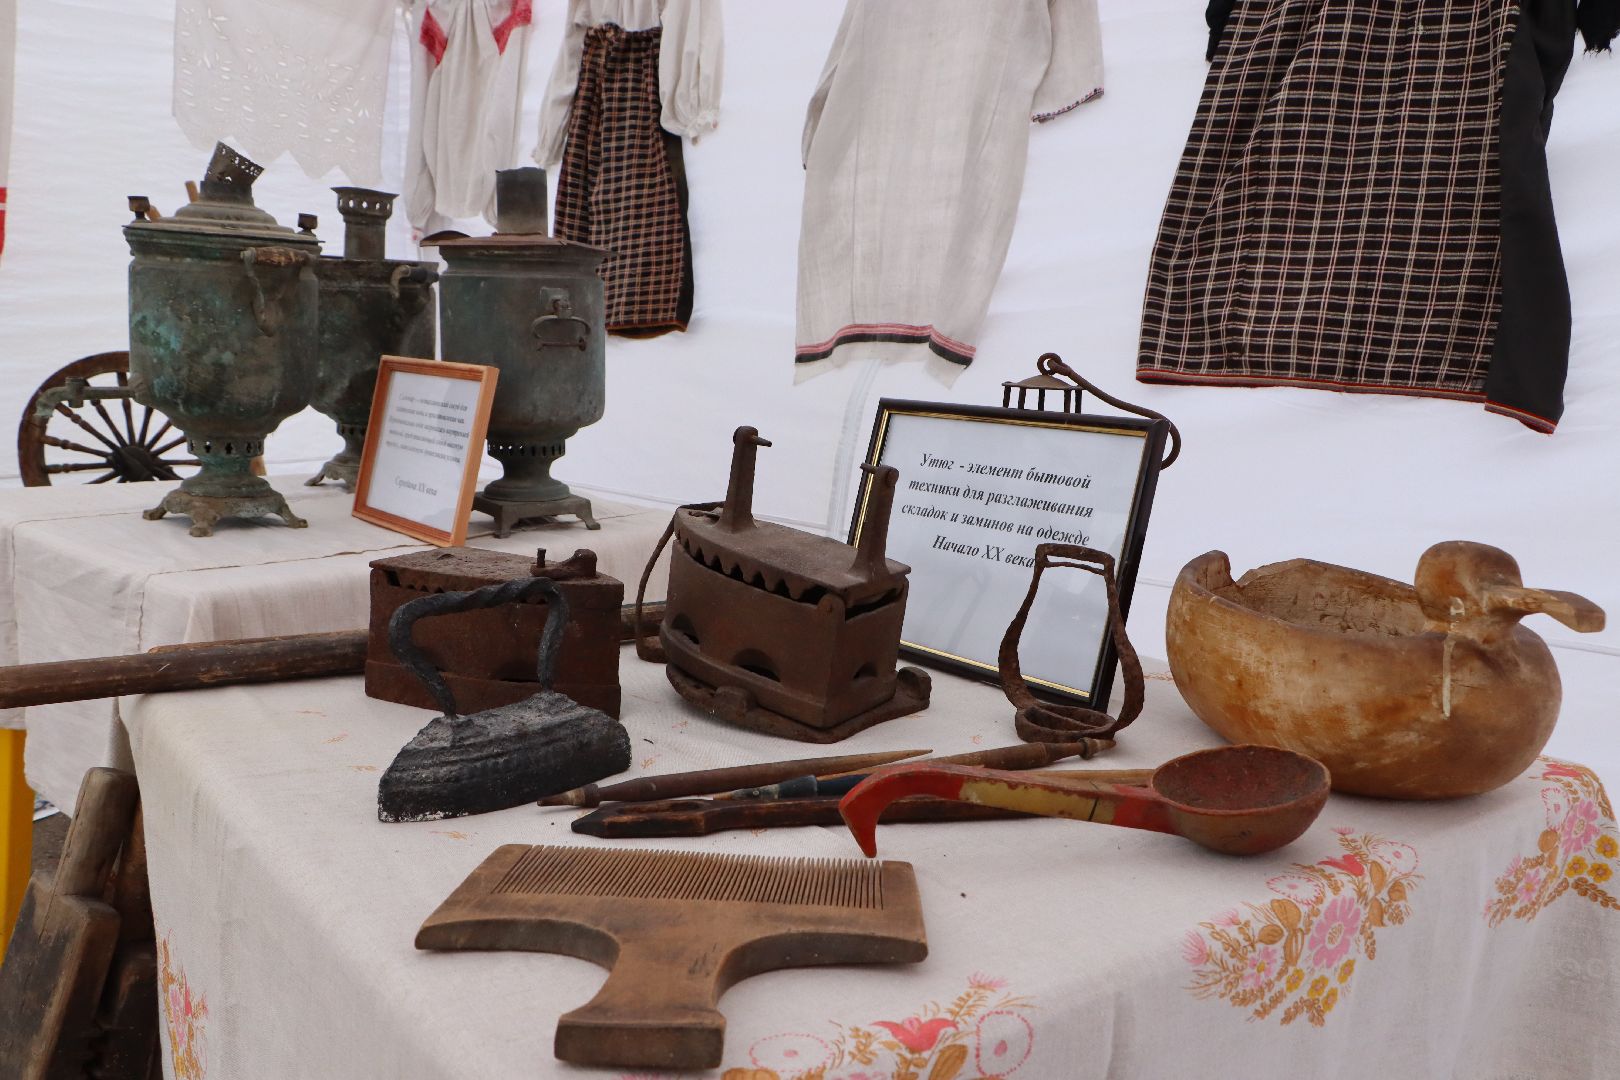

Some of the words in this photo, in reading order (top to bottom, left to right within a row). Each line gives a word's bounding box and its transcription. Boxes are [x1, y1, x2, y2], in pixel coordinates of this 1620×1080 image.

[920, 453, 955, 470] Утюг
[966, 461, 1024, 480] элемент
[1026, 466, 1092, 489] бытовой
[908, 479, 960, 497] техники
[962, 485, 984, 501] для
[985, 491, 1094, 518] разглаживания
[901, 502, 948, 521] складок
[950, 512, 960, 523] и
[960, 513, 1014, 533] заминов
[1016, 523, 1034, 537] на
[1036, 525, 1090, 546] одежде
[932, 534, 980, 557] Начало
[981, 544, 1005, 562] XX
[1005, 553, 1036, 568] века
